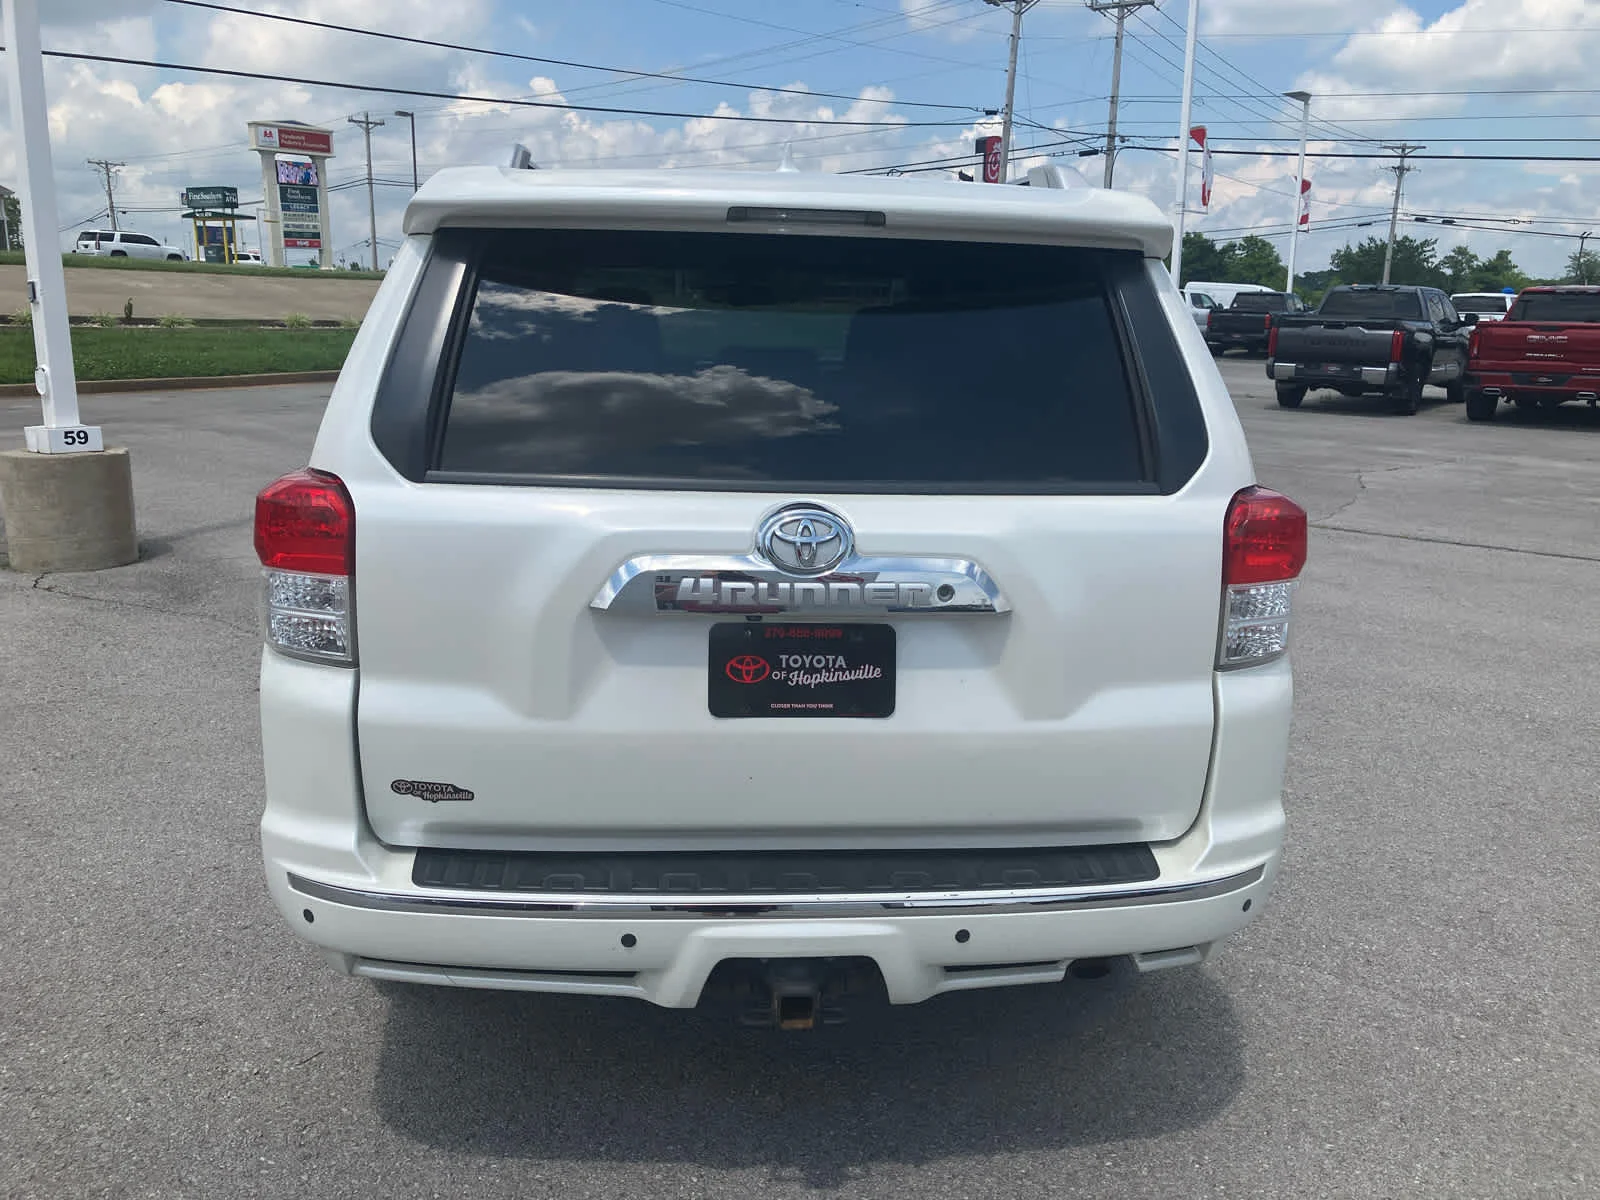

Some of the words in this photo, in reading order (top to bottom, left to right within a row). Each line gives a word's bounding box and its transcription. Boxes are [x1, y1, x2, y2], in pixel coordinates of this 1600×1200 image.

[63, 430, 89, 446] 59
[779, 654, 848, 669] TOYOTA
[771, 671, 788, 680] OF
[787, 663, 882, 689] Hopkinsville
[413, 783, 454, 792] TOYOTA
